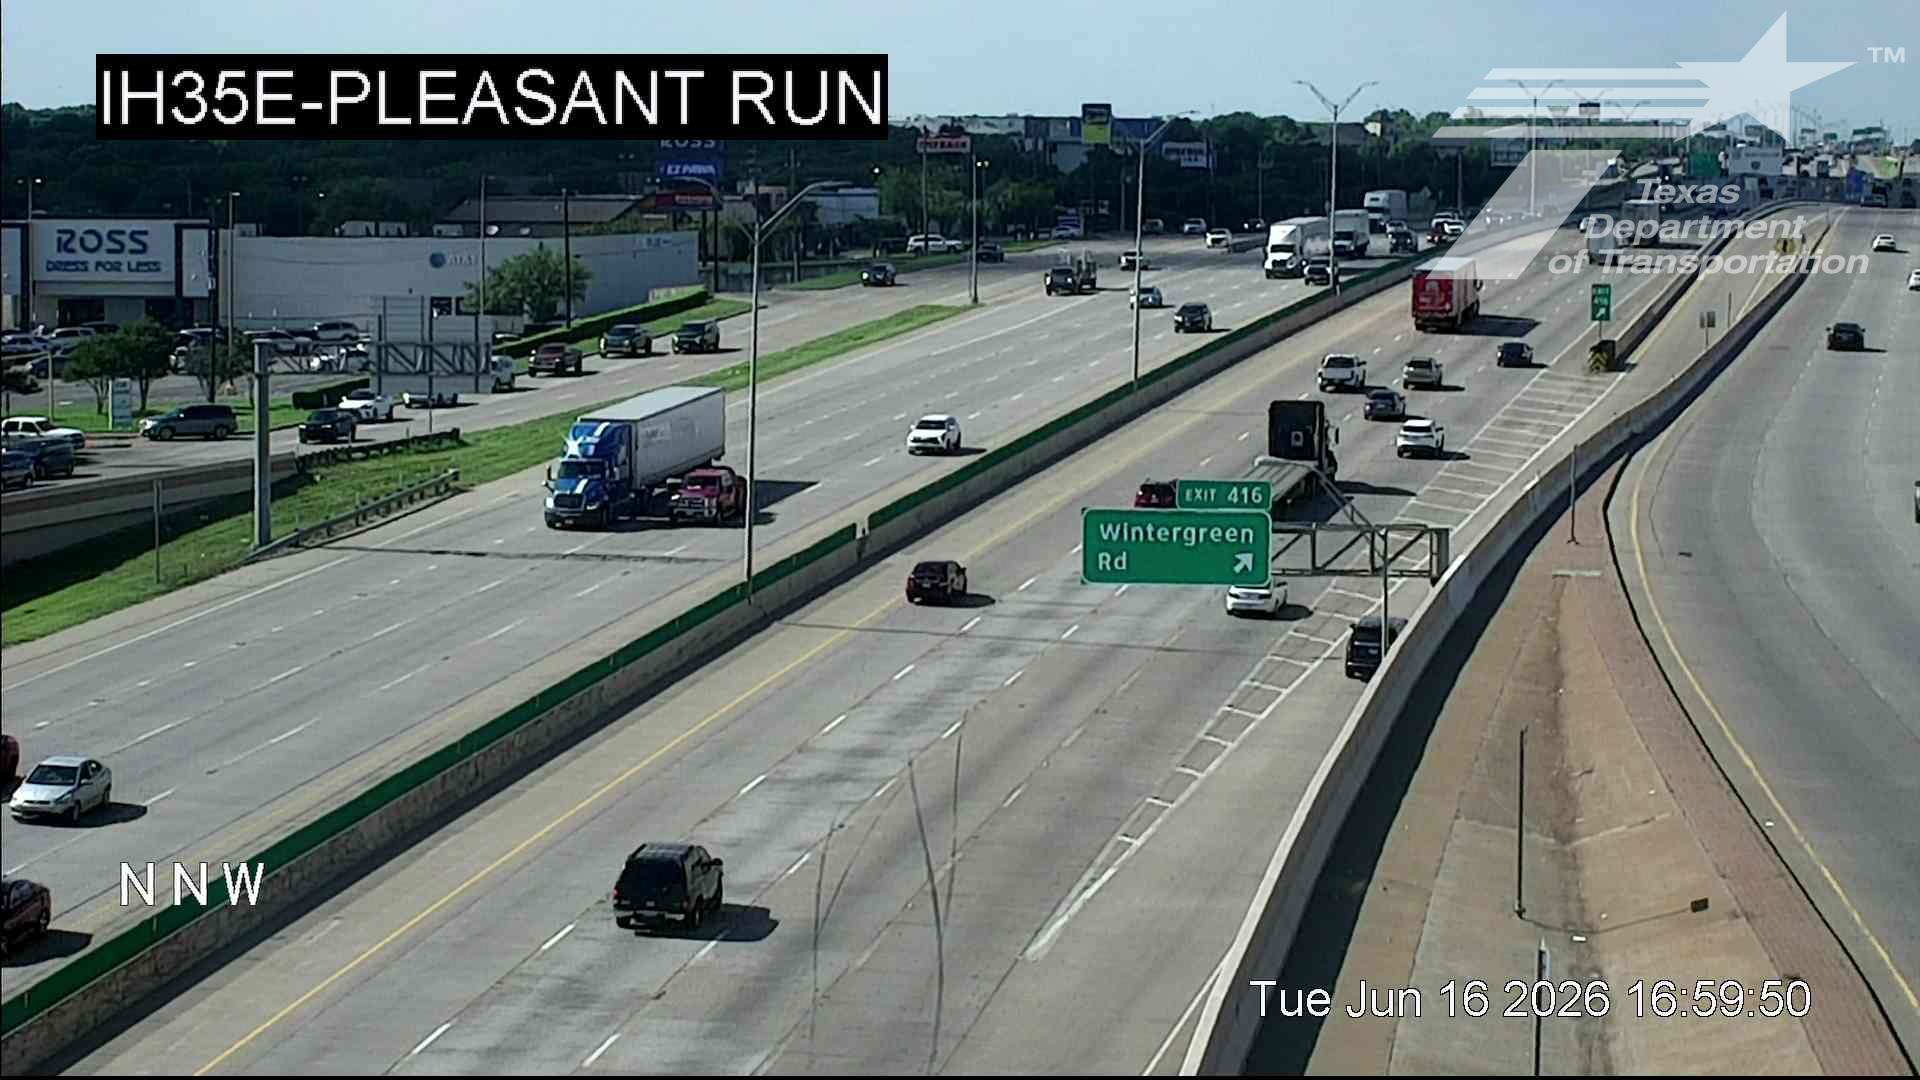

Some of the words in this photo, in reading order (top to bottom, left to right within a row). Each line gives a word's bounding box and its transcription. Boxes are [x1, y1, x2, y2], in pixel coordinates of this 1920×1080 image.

[56, 229, 149, 255] ROSS
[46, 260, 89, 273] DRESS
[94, 260, 123, 273] FOR
[127, 260, 162, 273] LESS
[1184, 488, 1217, 502] EXIT
[1226, 486, 1263, 504] 416
[1099, 523, 1255, 547] Wintergreen
[1098, 552, 1128, 571] Rd
